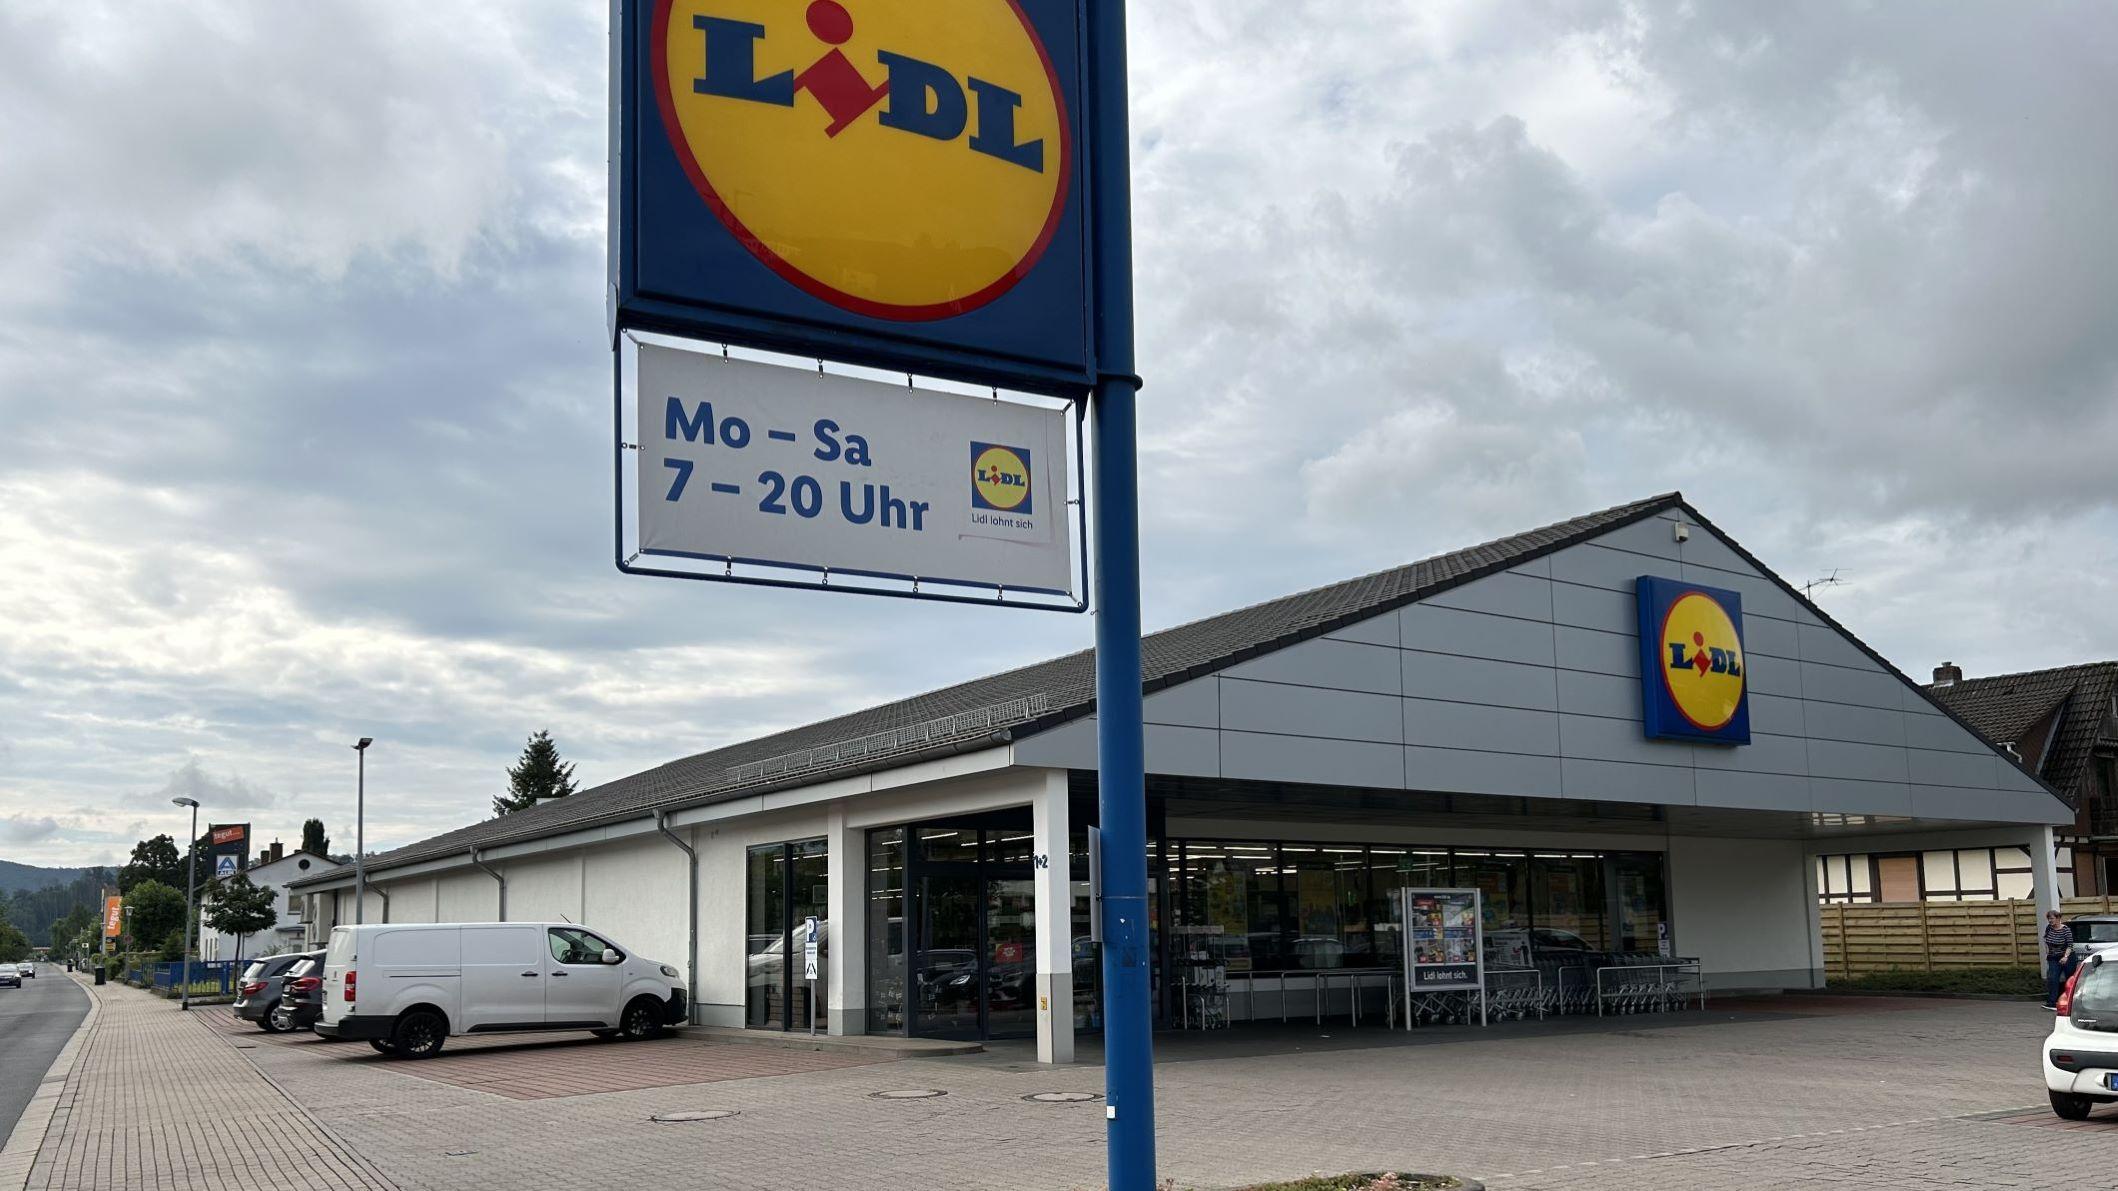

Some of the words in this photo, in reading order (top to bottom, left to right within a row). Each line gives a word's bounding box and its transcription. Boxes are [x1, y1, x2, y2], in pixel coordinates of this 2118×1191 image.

[665, 397, 750, 449] Mo
[813, 419, 871, 467] Sa
[663, 458, 693, 501] 7
[758, 471, 822, 518] 20
[840, 481, 929, 531] Uhr
[971, 512, 988, 525] Lidl
[990, 515, 1013, 528] lohnt
[1016, 519, 1033, 530] sich
[1423, 971, 1435, 980] Lidl
[1437, 970, 1452, 980] lohnt
